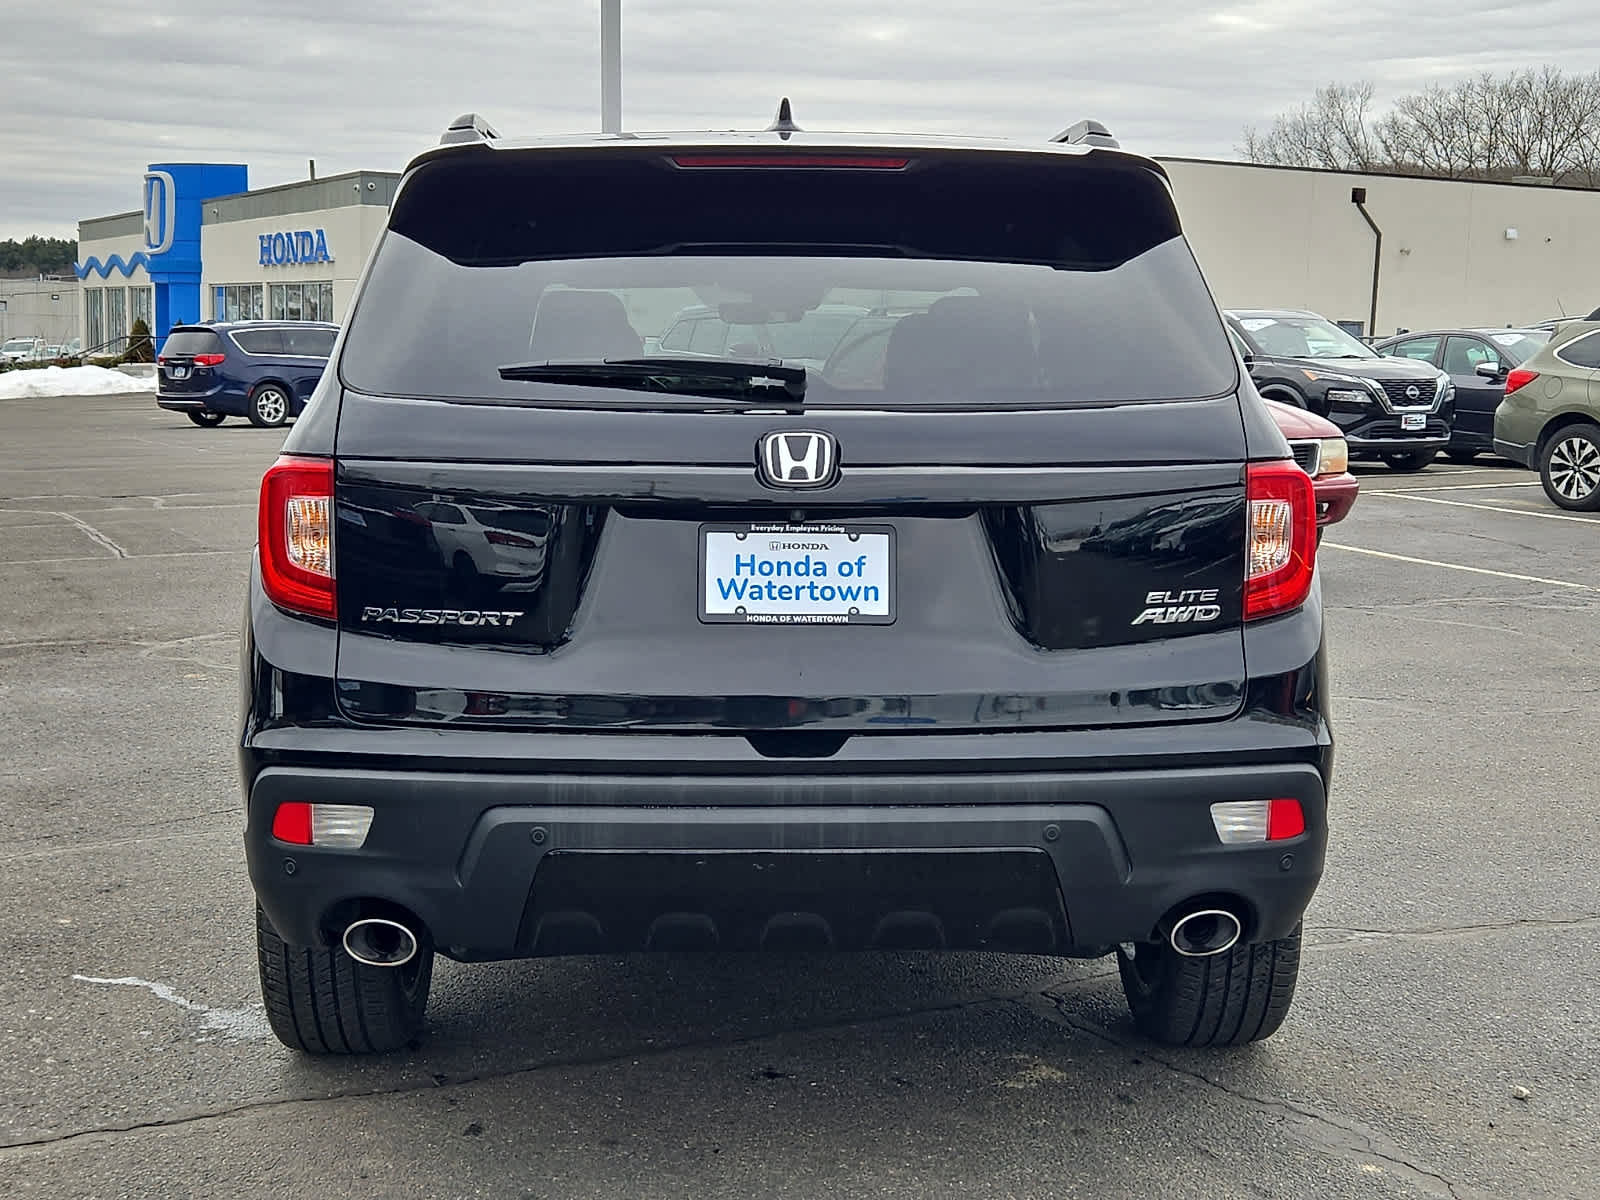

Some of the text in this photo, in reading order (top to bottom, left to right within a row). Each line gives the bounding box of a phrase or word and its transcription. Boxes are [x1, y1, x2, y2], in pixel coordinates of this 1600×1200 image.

[258, 228, 330, 265] HONDA
[751, 524, 845, 533] Everyday Employee Pricing
[735, 554, 867, 577] Honda of
[717, 578, 879, 601] Watertown
[1145, 588, 1219, 604] ELITE
[361, 606, 525, 626] PASSPORT
[746, 614, 849, 623] HONDA OF WATERTOWN
[1130, 604, 1221, 626] AWD
